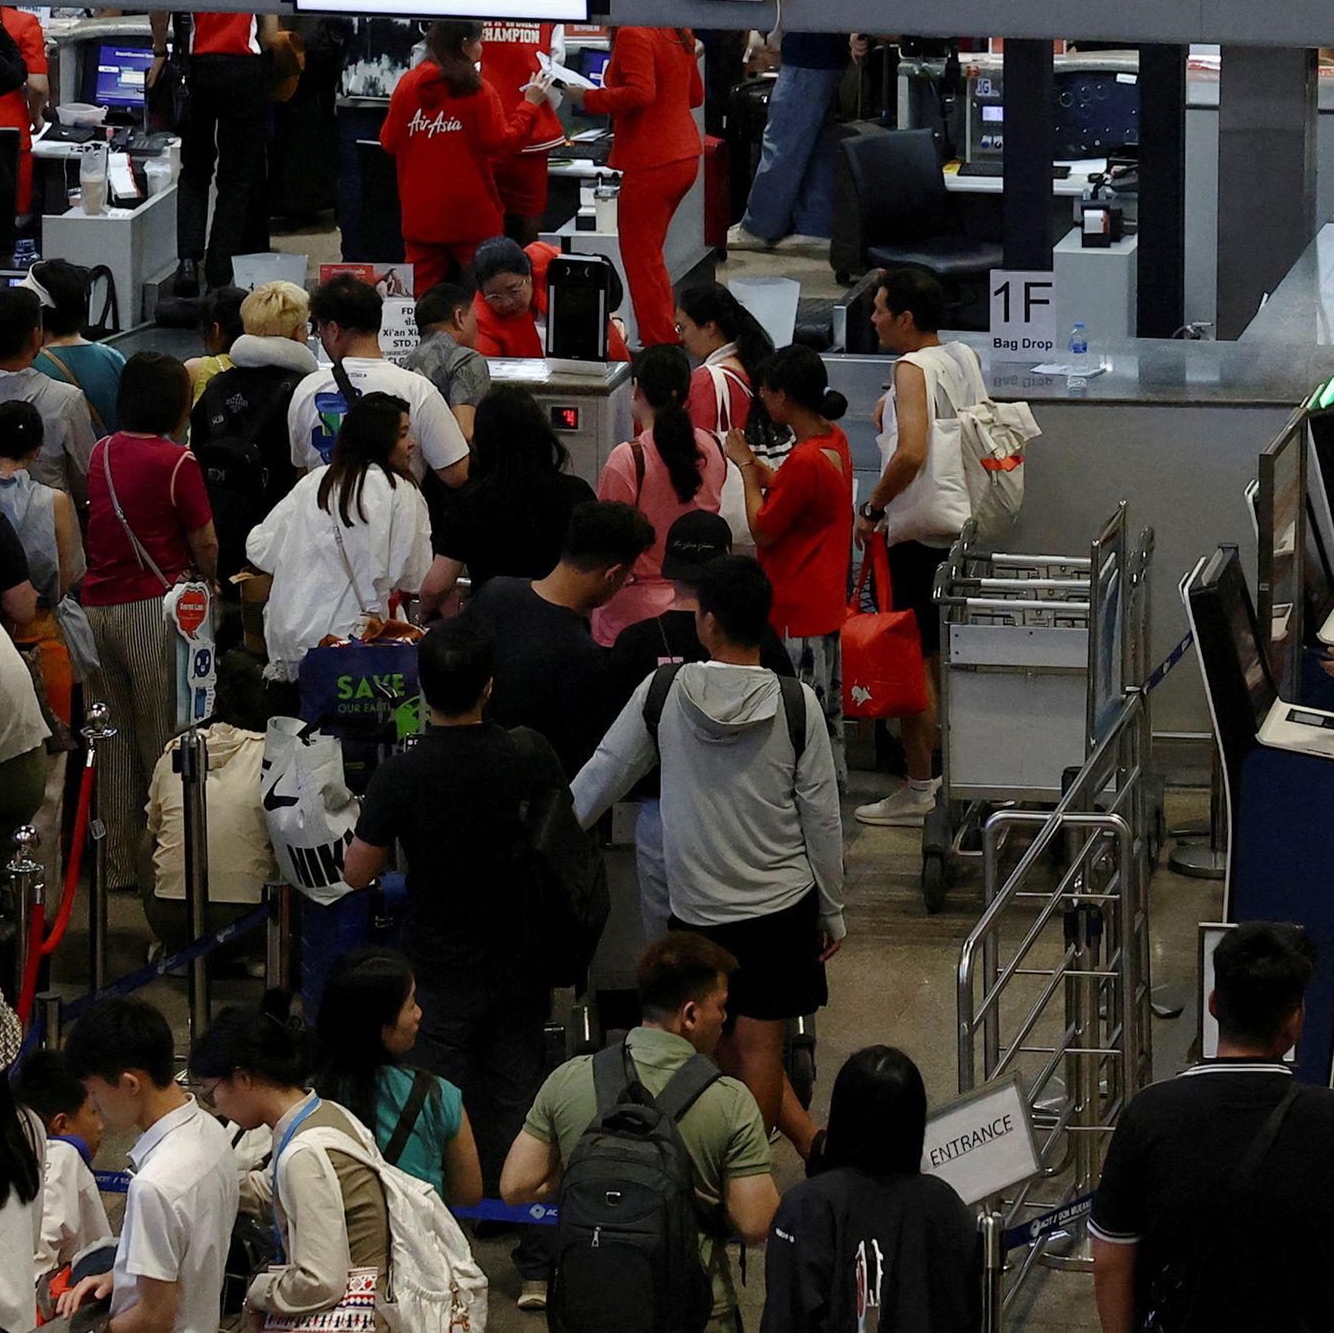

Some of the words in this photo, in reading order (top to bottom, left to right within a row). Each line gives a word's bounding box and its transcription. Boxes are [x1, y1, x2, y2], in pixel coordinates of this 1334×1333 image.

[993, 280, 1053, 323] 1F
[382, 328, 405, 337] Xi'an
[993, 337, 1018, 351] Bag
[1022, 337, 1053, 351] Drop
[337, 673, 405, 699] SAVE
[338, 703, 361, 714] OUR
[286, 828, 355, 889] NIK
[929, 1114, 1014, 1167] ENTRANCE
